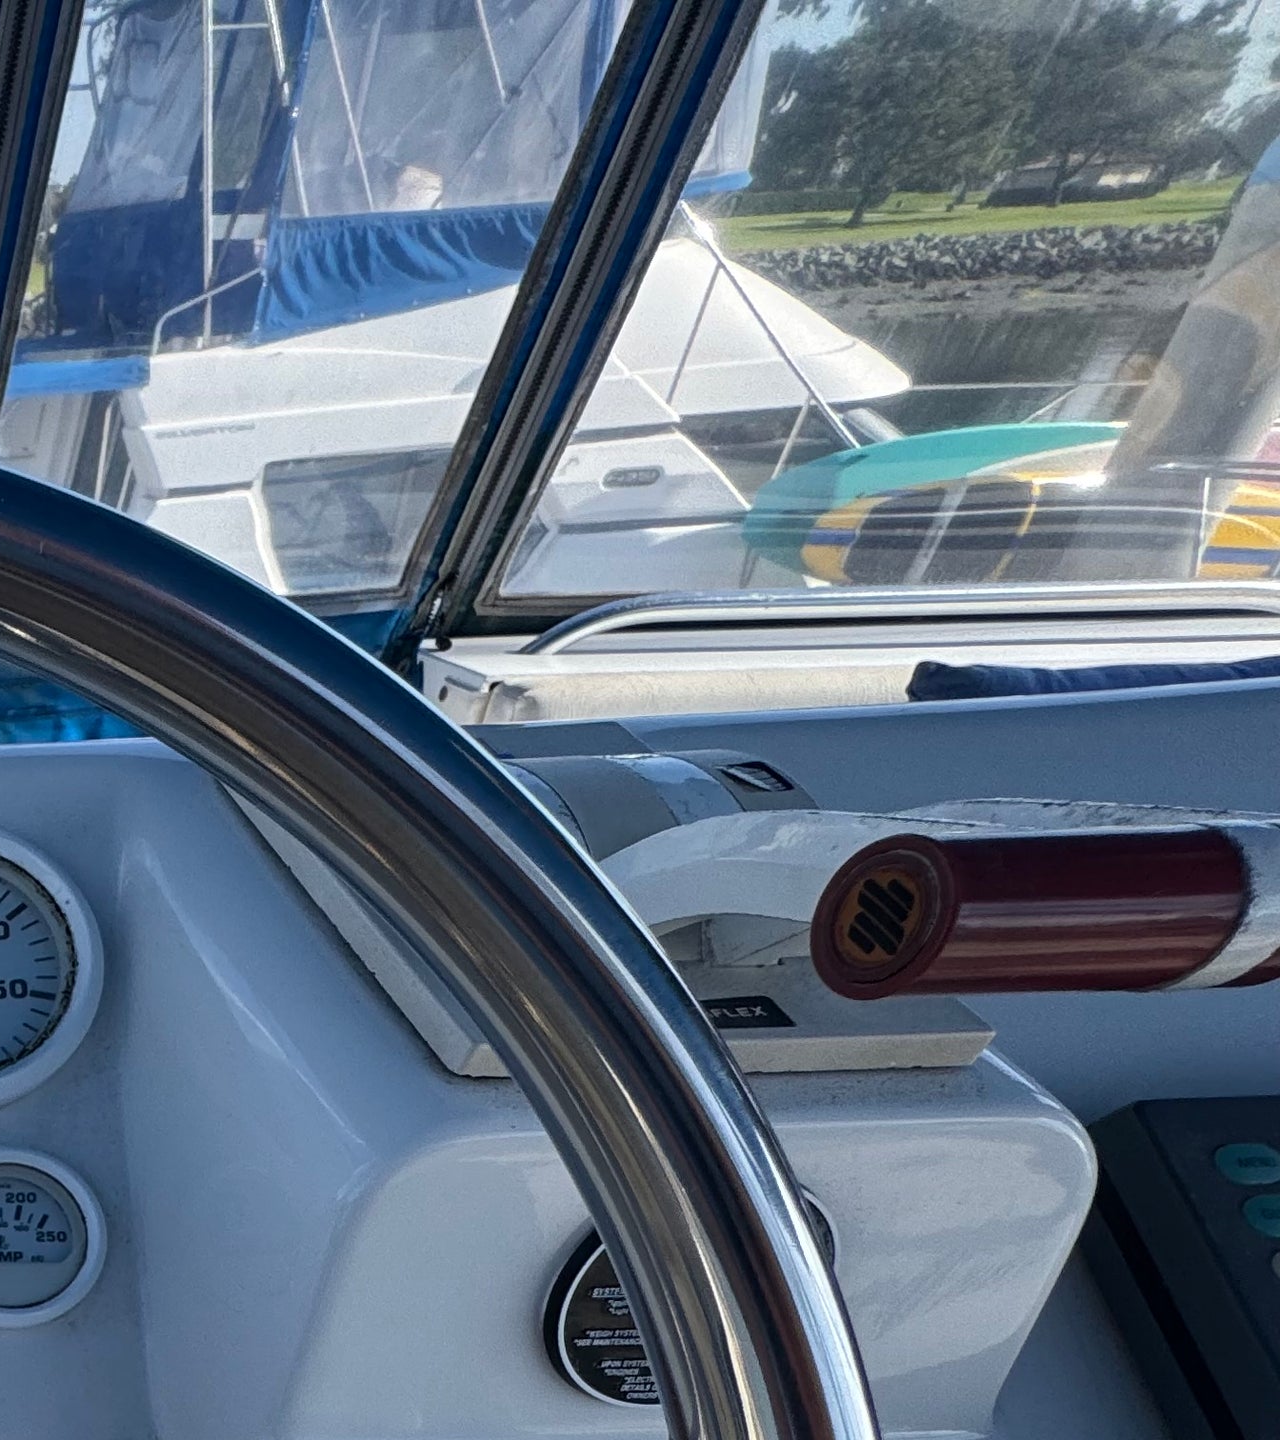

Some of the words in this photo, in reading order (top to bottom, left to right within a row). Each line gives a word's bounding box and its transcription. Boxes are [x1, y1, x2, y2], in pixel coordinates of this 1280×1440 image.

[707, 1006, 769, 1019] FLEX
[5, 1191, 37, 1204] 200
[35, 1230, 68, 1243] 250
